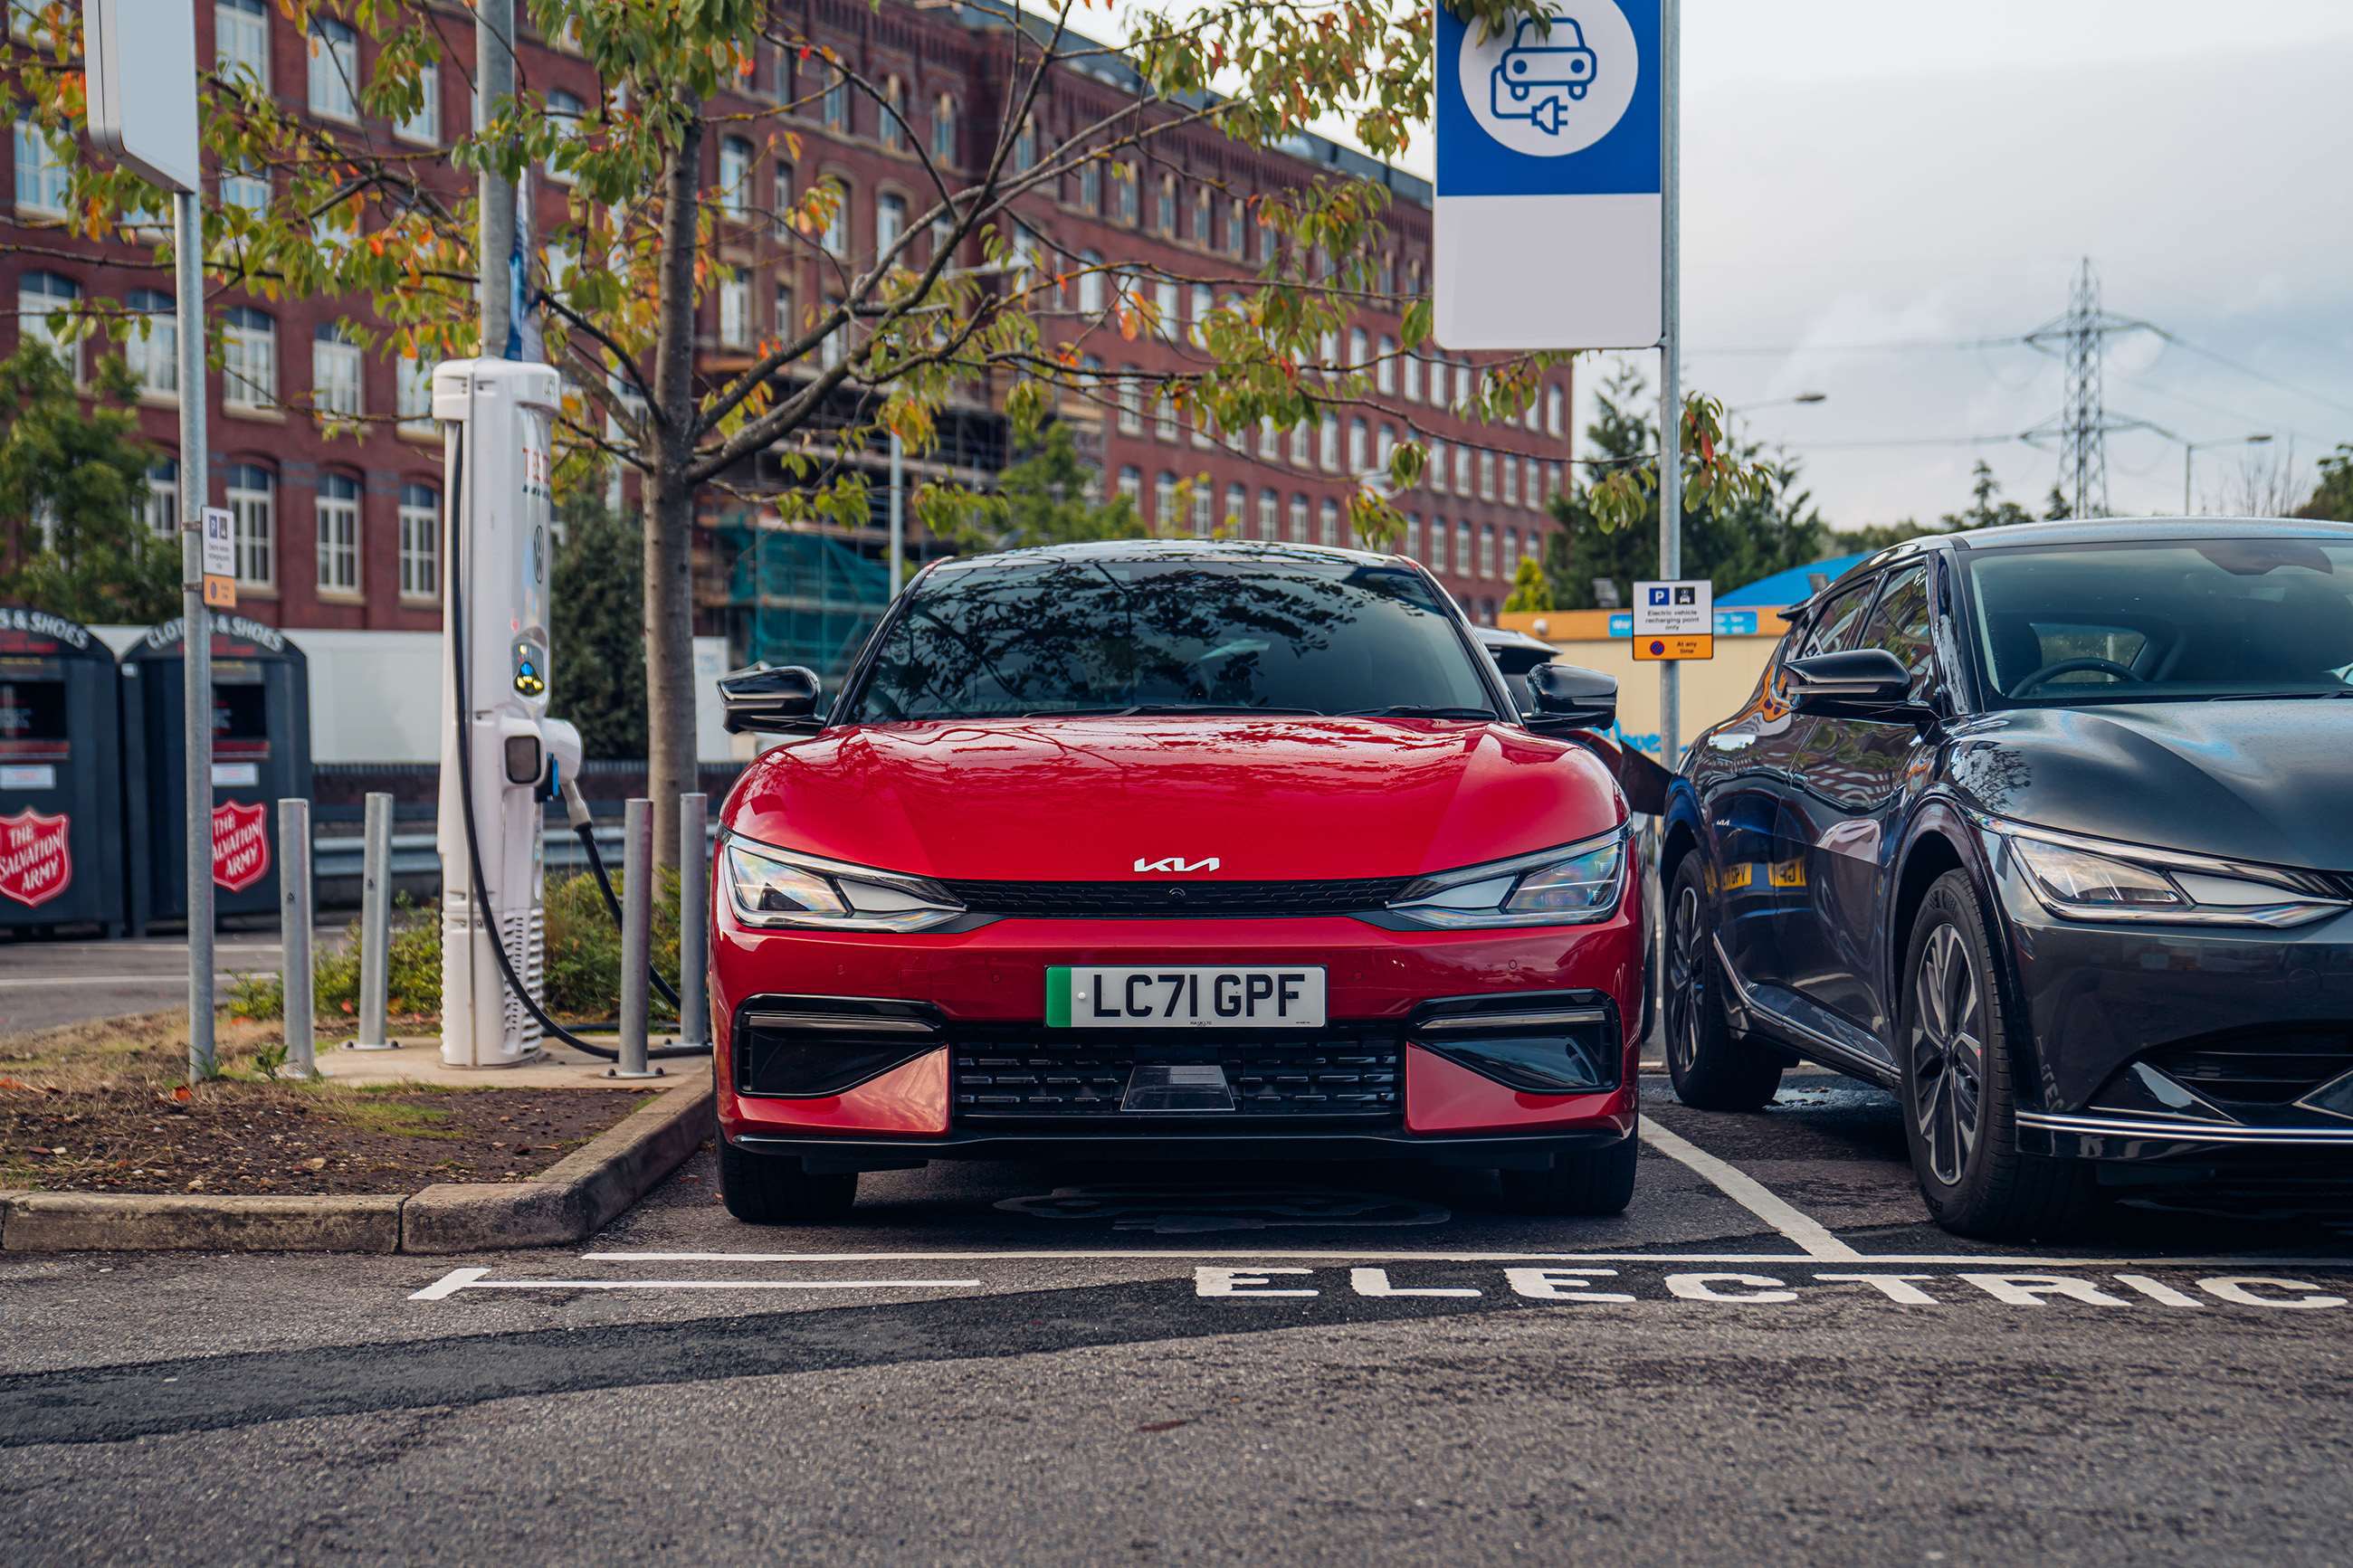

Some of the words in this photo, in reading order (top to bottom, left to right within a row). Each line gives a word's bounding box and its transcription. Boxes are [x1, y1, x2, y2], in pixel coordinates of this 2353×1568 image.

[1655, 591, 1664, 603] P
[29, 611, 90, 651] SHOES
[232, 615, 285, 653] SHOES
[8, 823, 33, 850] THE
[212, 817, 262, 862] ALVATION
[214, 813, 235, 838] THE
[0, 827, 61, 882] SALVATION
[225, 843, 258, 880] ARMY
[1134, 857, 1221, 872] KIA
[22, 856, 59, 893] ARMY
[1093, 974, 1198, 1018] LC71
[1214, 974, 1306, 1018] GPF
[1194, 1266, 2348, 1308] ELECTRIC
